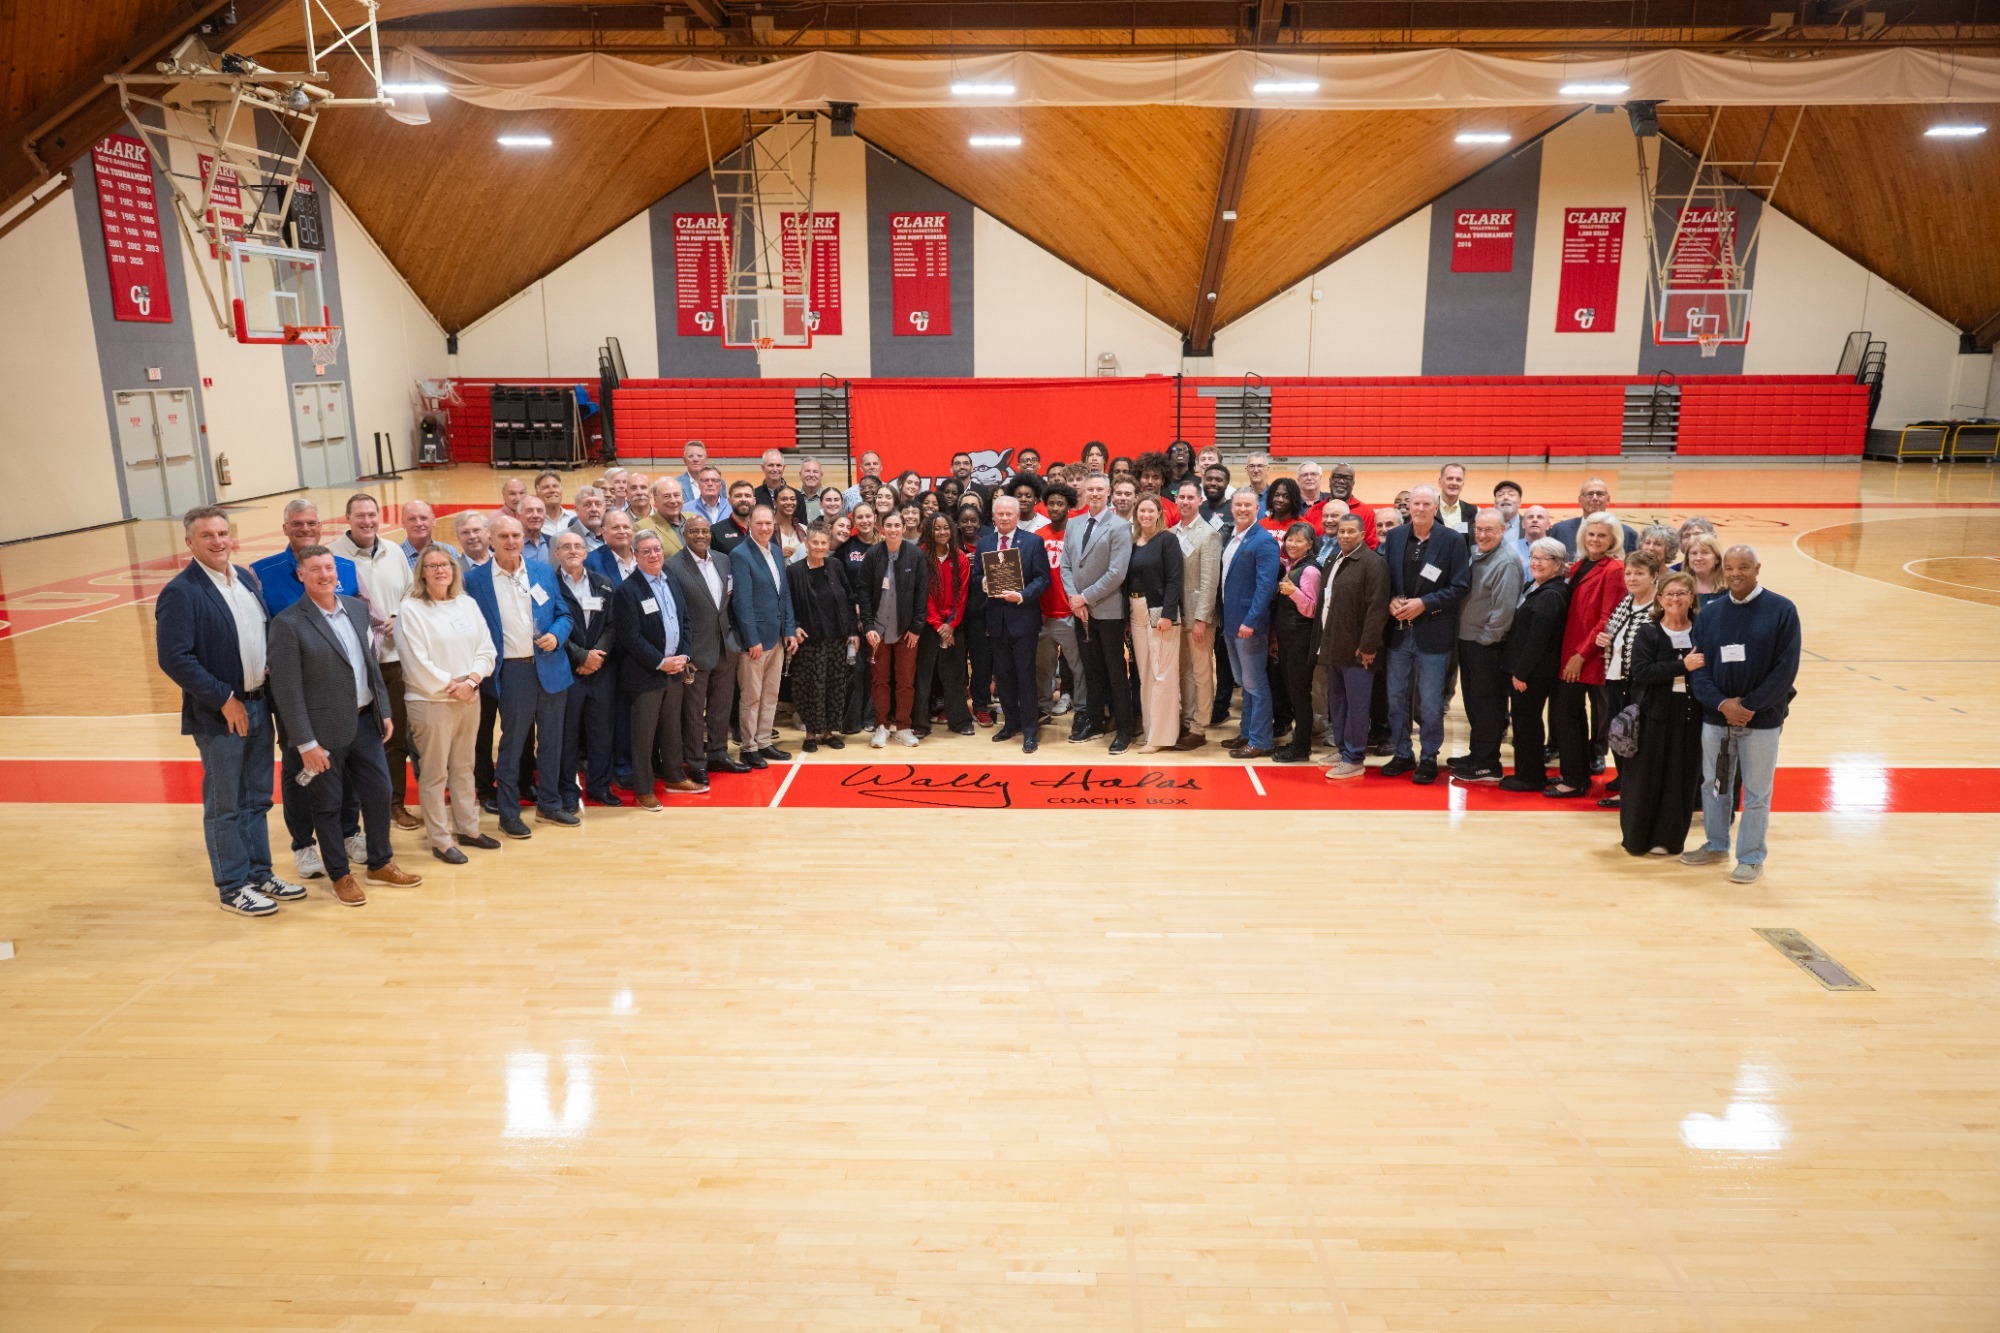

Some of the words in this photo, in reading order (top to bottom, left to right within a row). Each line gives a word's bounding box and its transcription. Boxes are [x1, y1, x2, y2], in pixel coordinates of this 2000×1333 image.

[113, 158, 145, 170] BASKETBALL
[203, 161, 236, 178] CARK
[110, 168, 152, 182] TOURNAMENT
[101, 179, 113, 188] 978
[117, 182, 132, 192] 1979
[137, 200, 153, 210] 1983
[676, 217, 729, 229] CLARK
[893, 216, 946, 228] CLARK
[1458, 213, 1512, 225] CLARK
[1568, 212, 1622, 224] CLARK
[840, 764, 1011, 808] Wally
[1029, 768, 1204, 792] Halas
[1047, 797, 1136, 805] COACH'S
[1145, 797, 1188, 805] BOX
